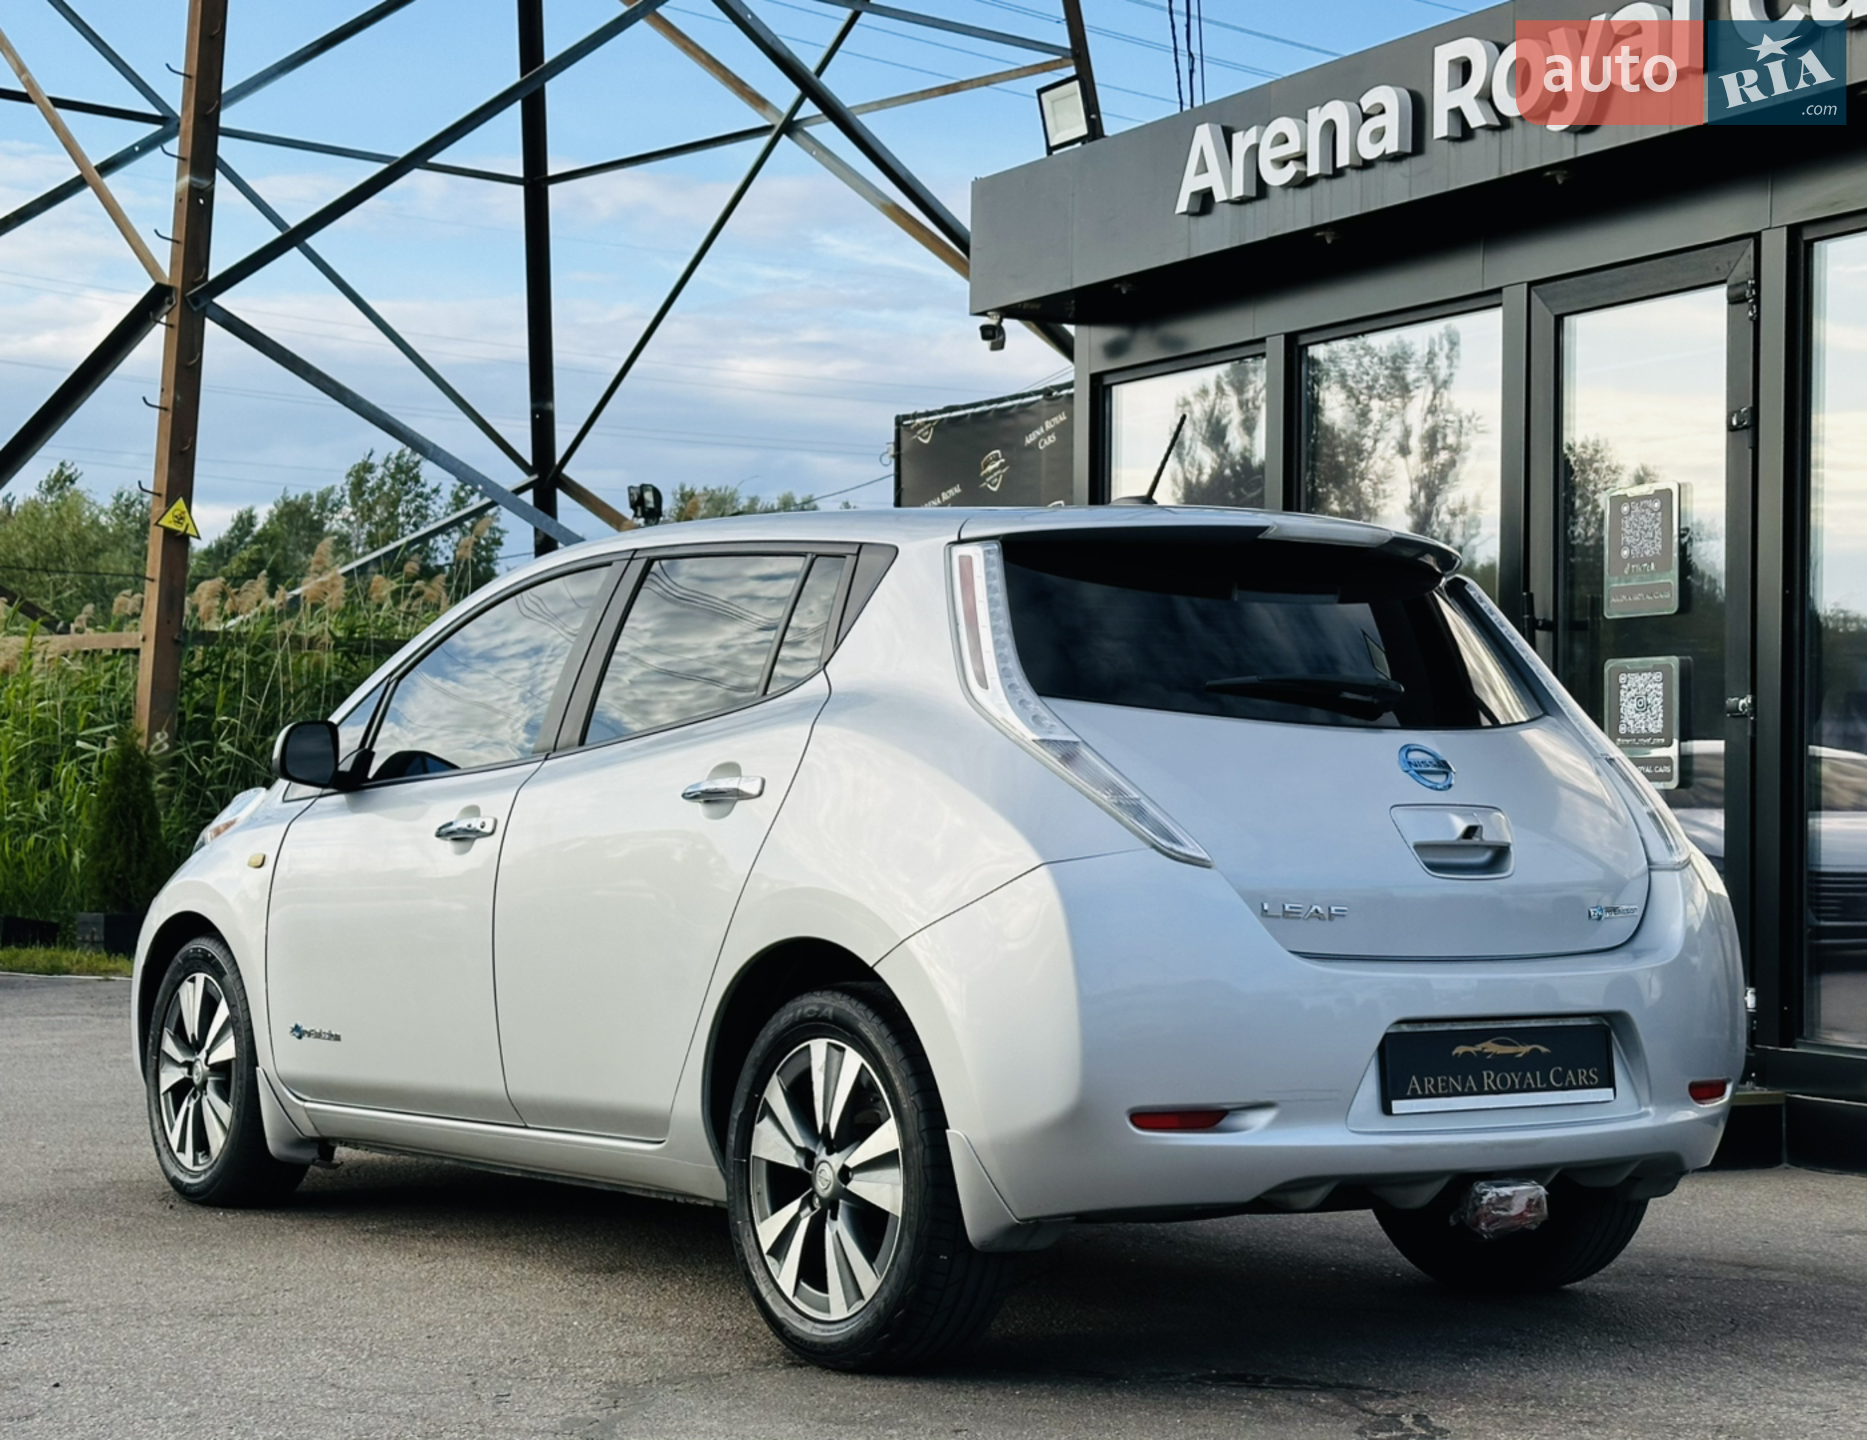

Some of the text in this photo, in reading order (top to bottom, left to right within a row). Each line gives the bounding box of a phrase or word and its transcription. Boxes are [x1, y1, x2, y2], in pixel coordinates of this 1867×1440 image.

[1175, 0, 1703, 215] Arena Royal
[1260, 901, 1349, 921] LEAF
[1406, 1066, 1599, 1096] ARENA ROYAL CARS
